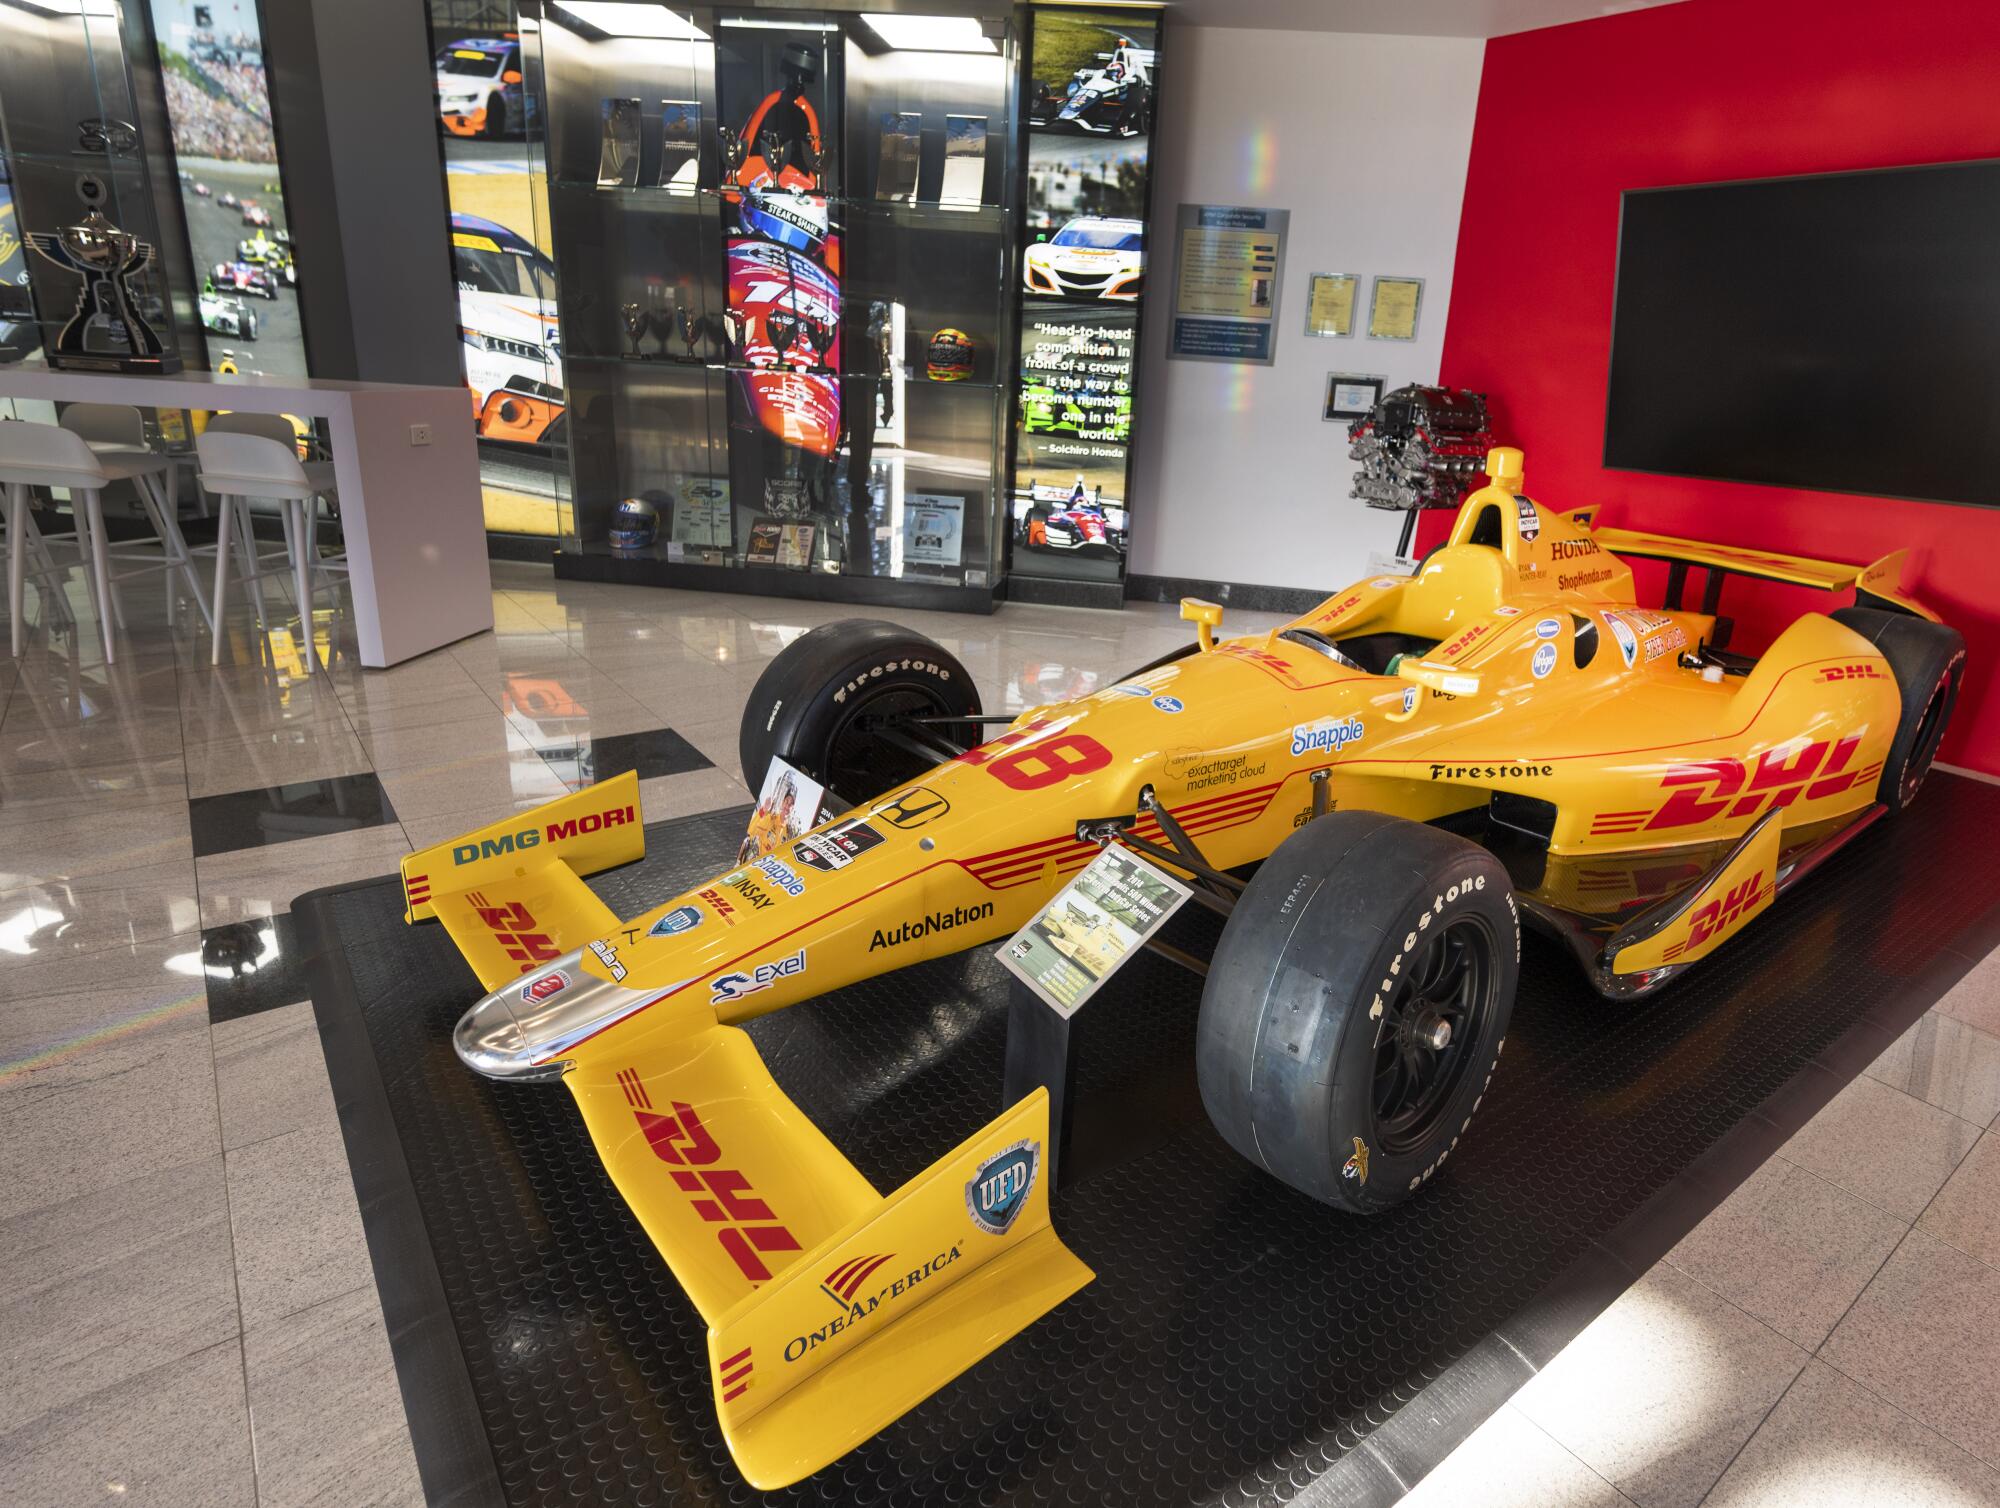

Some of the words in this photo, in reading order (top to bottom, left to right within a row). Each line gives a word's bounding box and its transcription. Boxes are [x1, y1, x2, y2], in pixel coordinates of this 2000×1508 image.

[768, 204, 792, 221] STEAK
[796, 217, 819, 236] SHAKE
[1035, 342, 1115, 357] competition
[1118, 345, 1130, 358] in
[1025, 355, 1058, 370] front
[1060, 359, 1076, 371] of
[1077, 362, 1085, 372] a
[1088, 361, 1129, 375] crowd
[1046, 375, 1057, 387] is
[1060, 376, 1081, 389] the
[1085, 380, 1111, 392] way
[1114, 379, 1129, 391] to
[1022, 390, 1074, 405] become
[1077, 395, 1127, 408] number
[1061, 411, 1086, 422] one
[1089, 411, 1101, 423] in
[1104, 413, 1126, 425] the
[1049, 444, 1090, 456] Soichiro
[1091, 446, 1124, 458] Honda
[1551, 538, 1600, 561] HONDA
[1558, 568, 1613, 591] ShopHonda.com
[1442, 626, 1489, 656] DHL
[834, 658, 950, 705] Firestone
[1819, 664, 1881, 682] DHL
[1291, 719, 1364, 756] Snapple
[1187, 755, 1247, 778] exacttarget
[1187, 771, 1237, 793] marketing
[1239, 763, 1266, 780] cloud
[1429, 763, 1553, 781] Firestone
[1643, 724, 1868, 830] DHL
[453, 829, 541, 866] DMG
[546, 806, 635, 843] MORI
[752, 854, 805, 896] Snapple
[698, 888, 736, 921] DHL
[1128, 888, 1140, 901] 500
[1139, 897, 1163, 916] Winner
[1129, 904, 1151, 923] Series
[1683, 870, 1764, 953] DHL
[666, 910, 692, 931] UFD
[869, 901, 994, 953] AutoNation
[1369, 875, 1486, 1021] Firestone
[633, 1101, 803, 1281] DHL
[979, 1161, 1027, 1211] UFD
